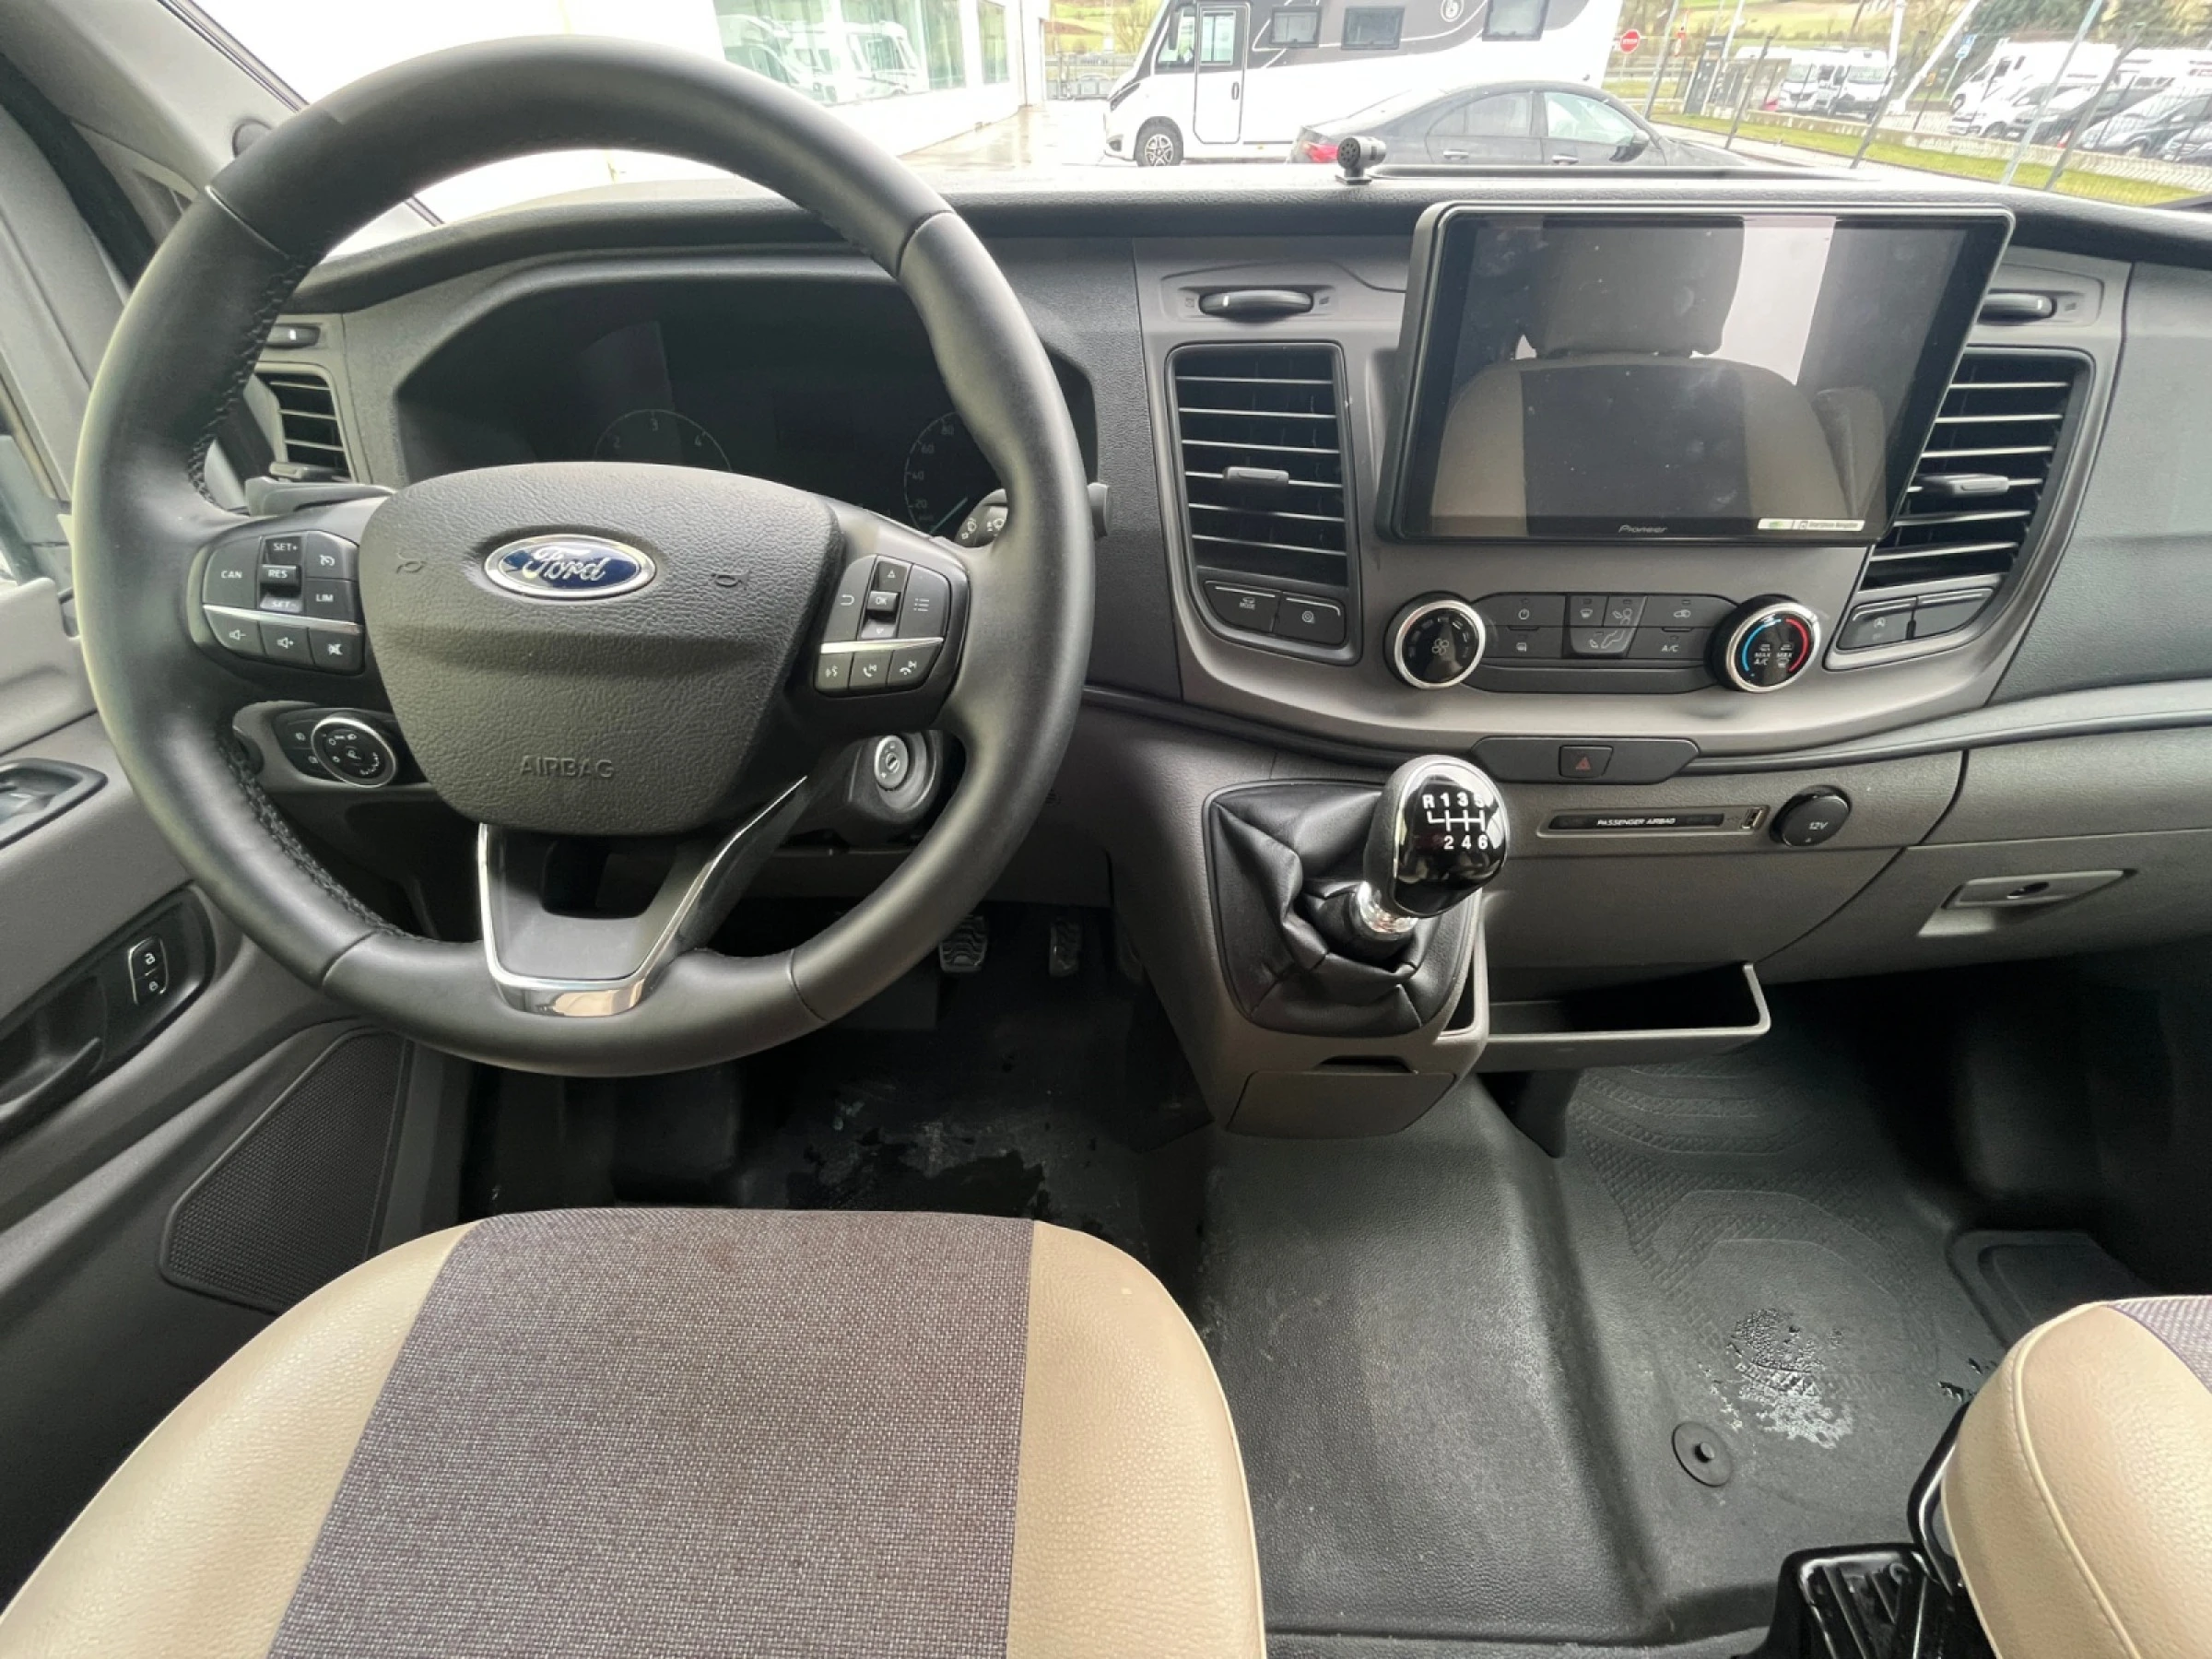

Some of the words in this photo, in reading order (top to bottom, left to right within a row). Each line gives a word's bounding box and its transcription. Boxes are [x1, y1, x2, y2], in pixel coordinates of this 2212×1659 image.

[1618, 524, 1668, 534] Pioneer
[273, 542, 299, 551] SET+
[522, 547, 611, 582] Ford
[220, 571, 243, 580] CAN
[267, 569, 288, 579] RES
[315, 594, 335, 603] LIM
[876, 596, 887, 606] OK
[1661, 644, 1679, 653] A/C
[520, 754, 615, 779] AIRBAG
[1422, 794, 1436, 808] R
[1440, 793, 1451, 807] 1
[1456, 792, 1469, 807] 3
[1475, 794, 1486, 808] 5
[1808, 821, 1829, 830] 12V
[1443, 835, 1455, 850] 2
[1461, 834, 1473, 850] 4
[1477, 834, 1488, 850] 6
